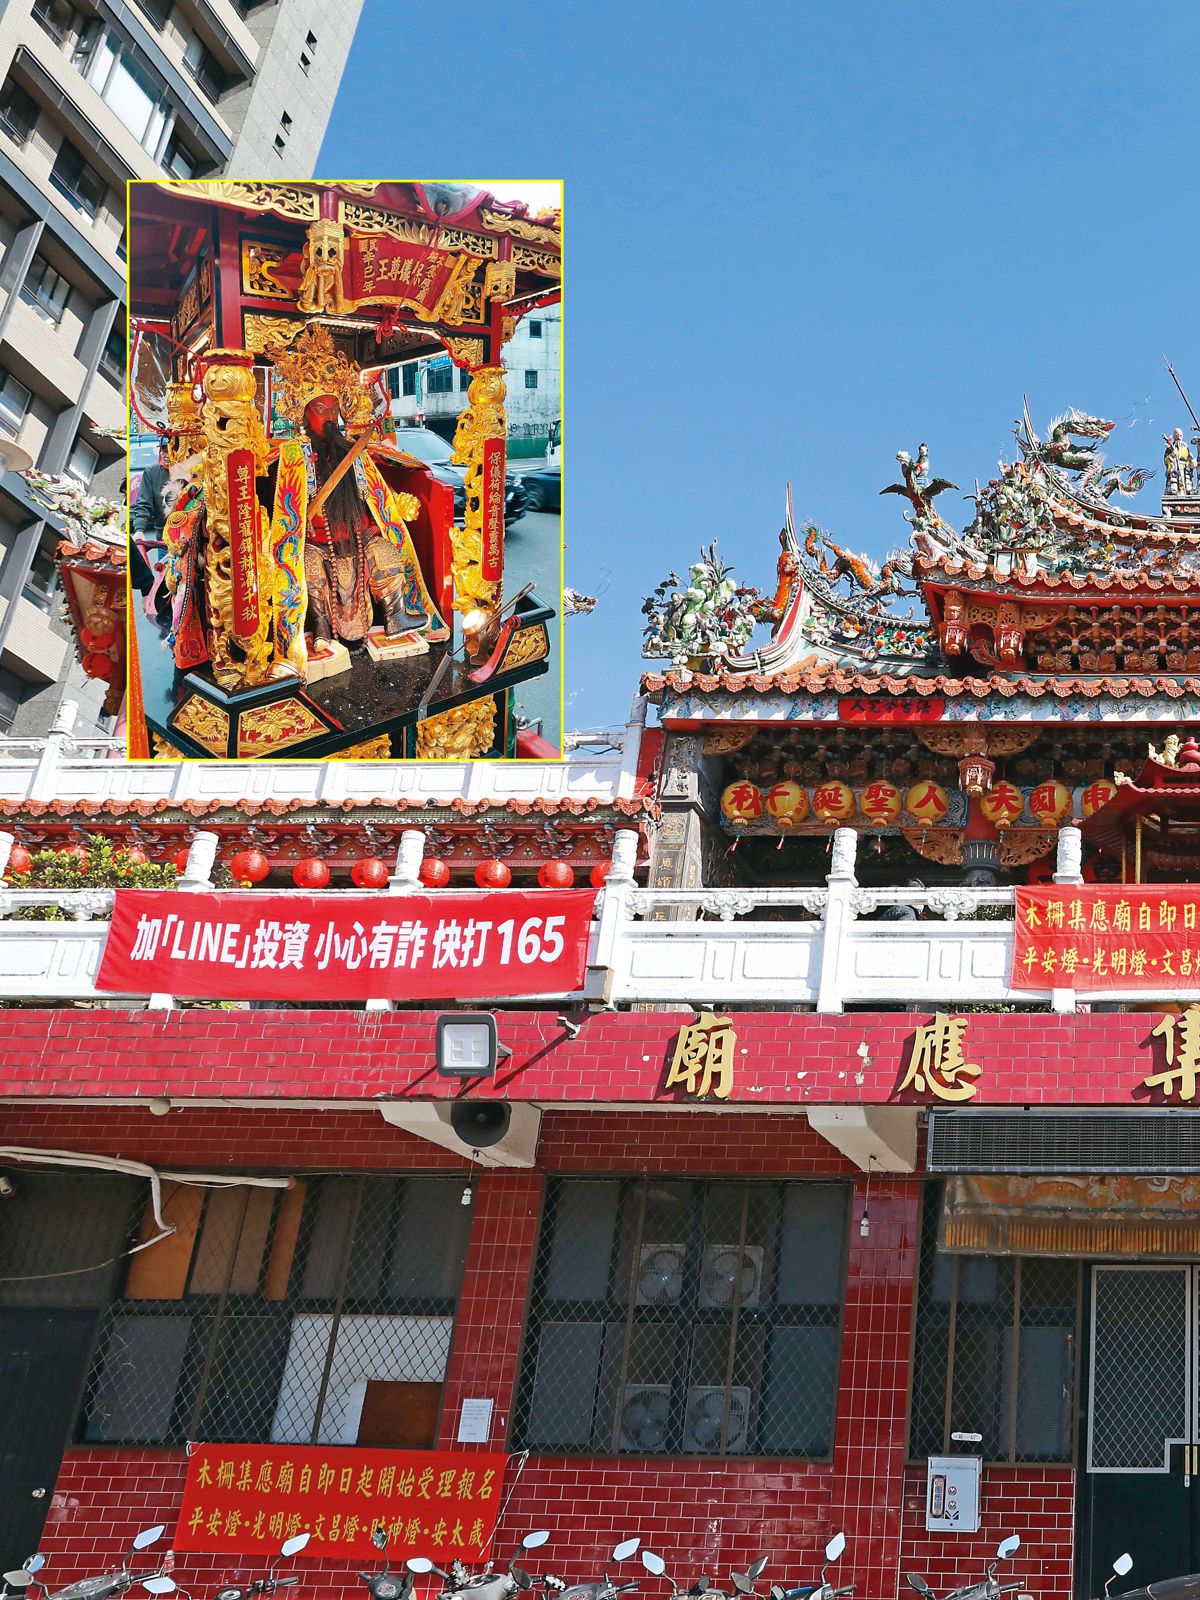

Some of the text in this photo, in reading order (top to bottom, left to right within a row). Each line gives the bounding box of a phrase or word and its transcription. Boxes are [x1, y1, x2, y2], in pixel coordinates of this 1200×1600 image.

[313, 917, 427, 969] 小心有詐
[432, 917, 486, 969] 快打
[497, 914, 566, 964] 165
[195, 1457, 496, 1501] 木柵集應廟自即日起開始受理報名
